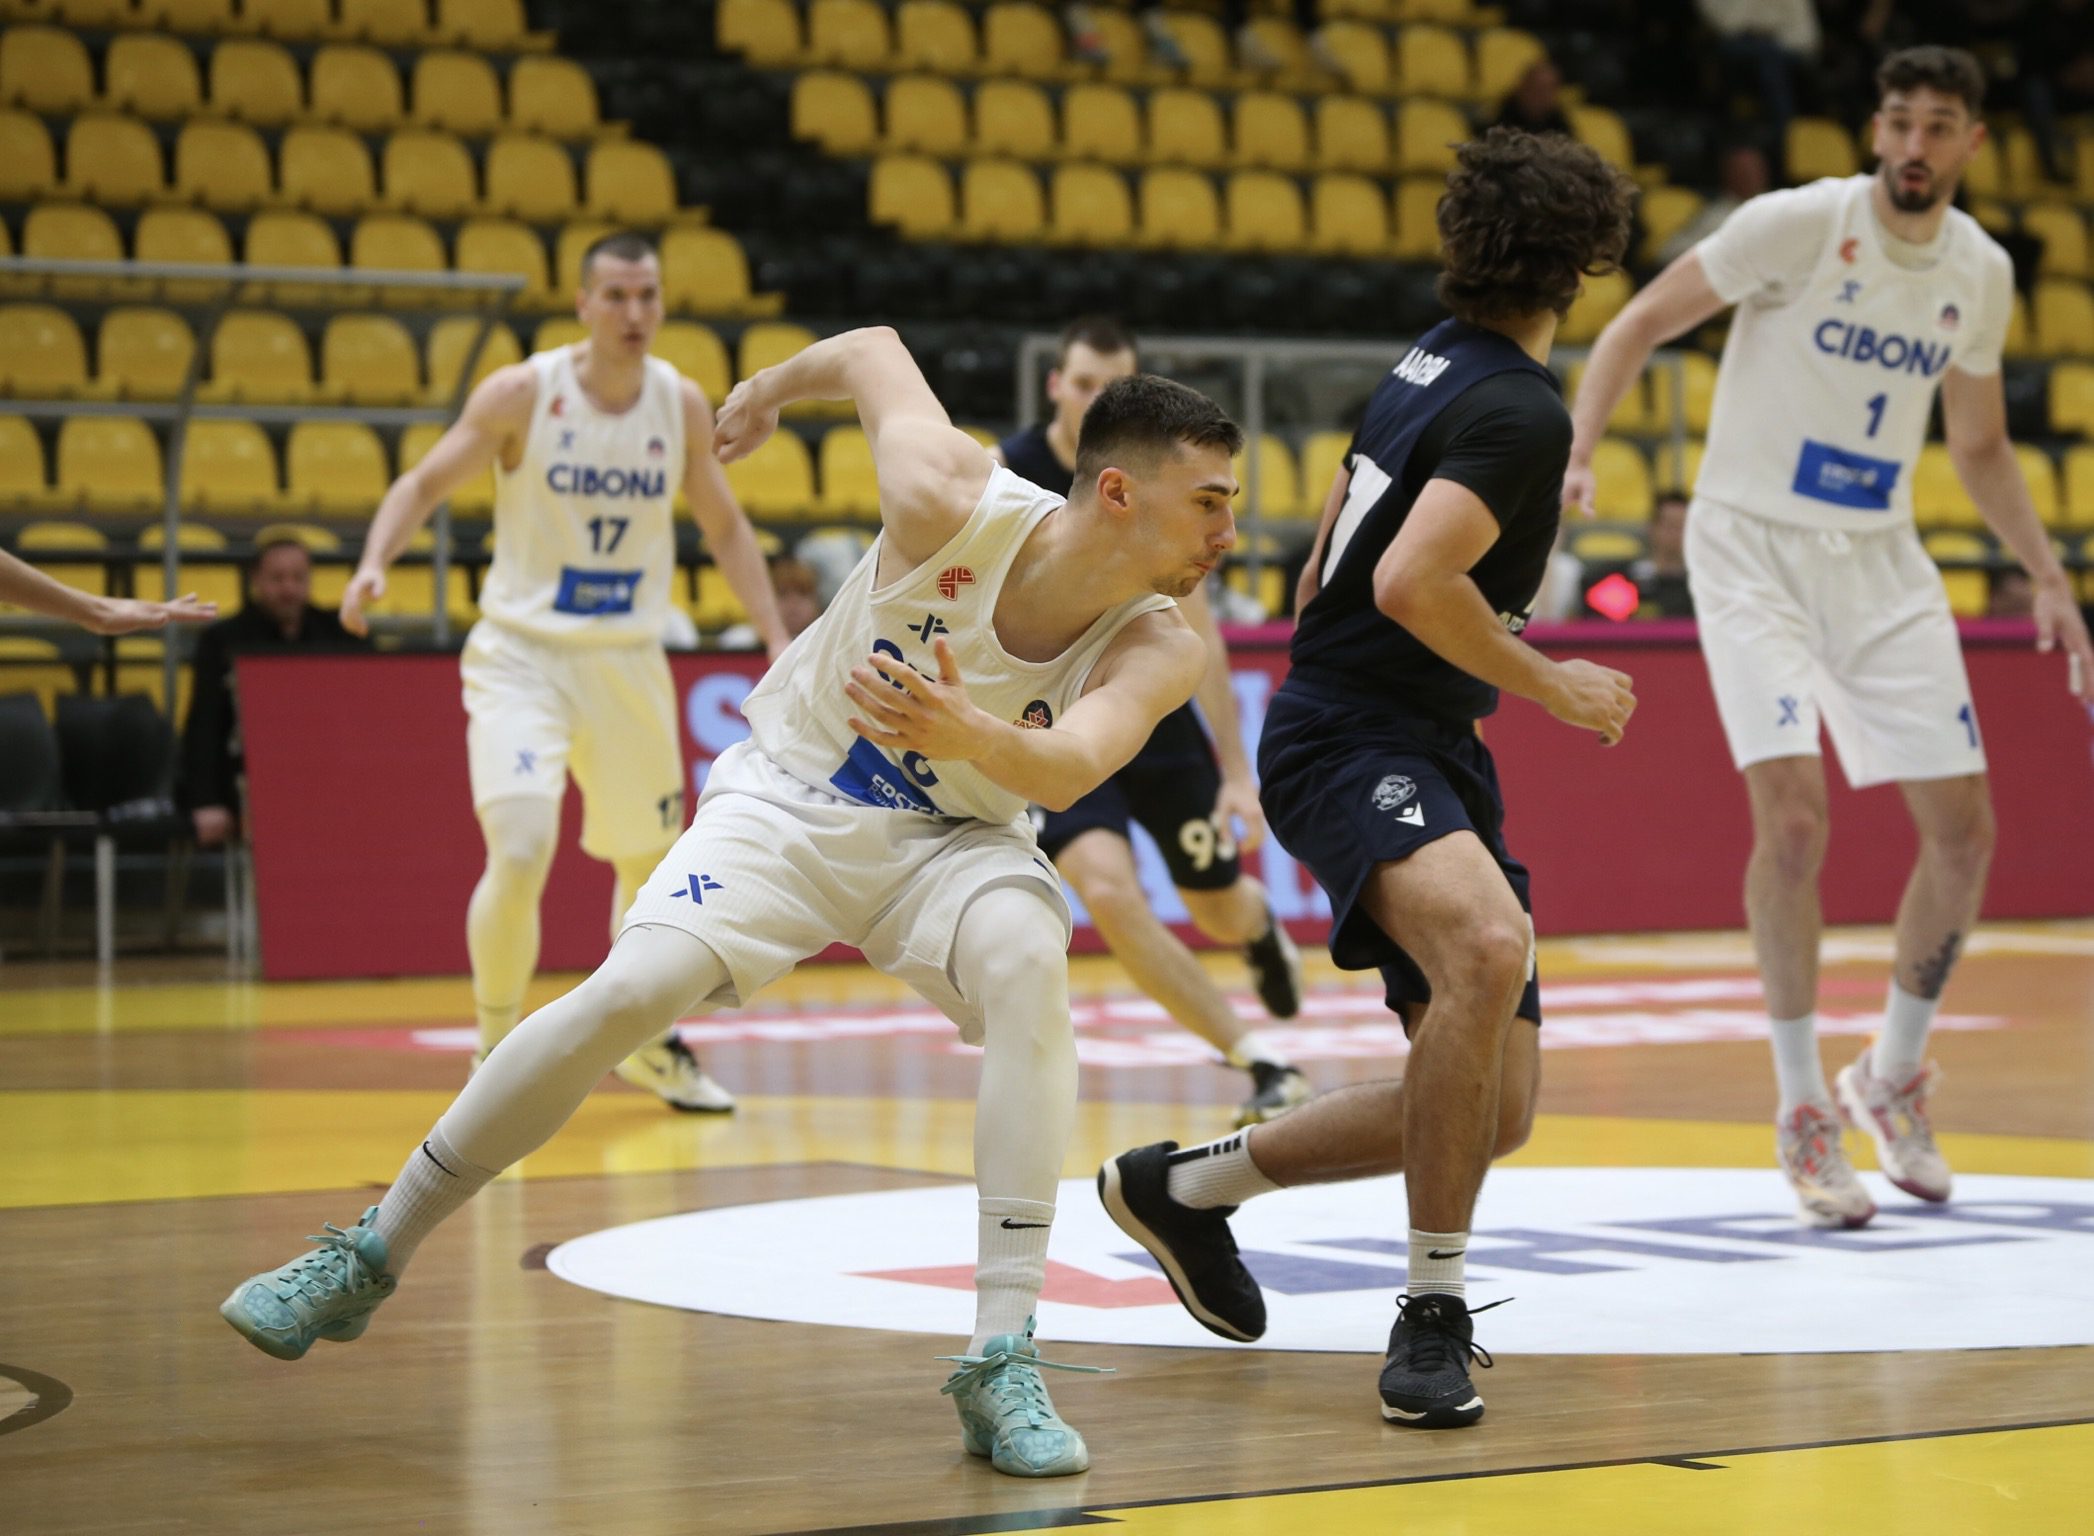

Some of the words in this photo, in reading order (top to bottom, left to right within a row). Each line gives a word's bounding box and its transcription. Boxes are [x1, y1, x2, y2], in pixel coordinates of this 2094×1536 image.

[1867, 393, 1888, 438] 1
[587, 517, 630, 554] 17
[1958, 704, 1977, 748] 1
